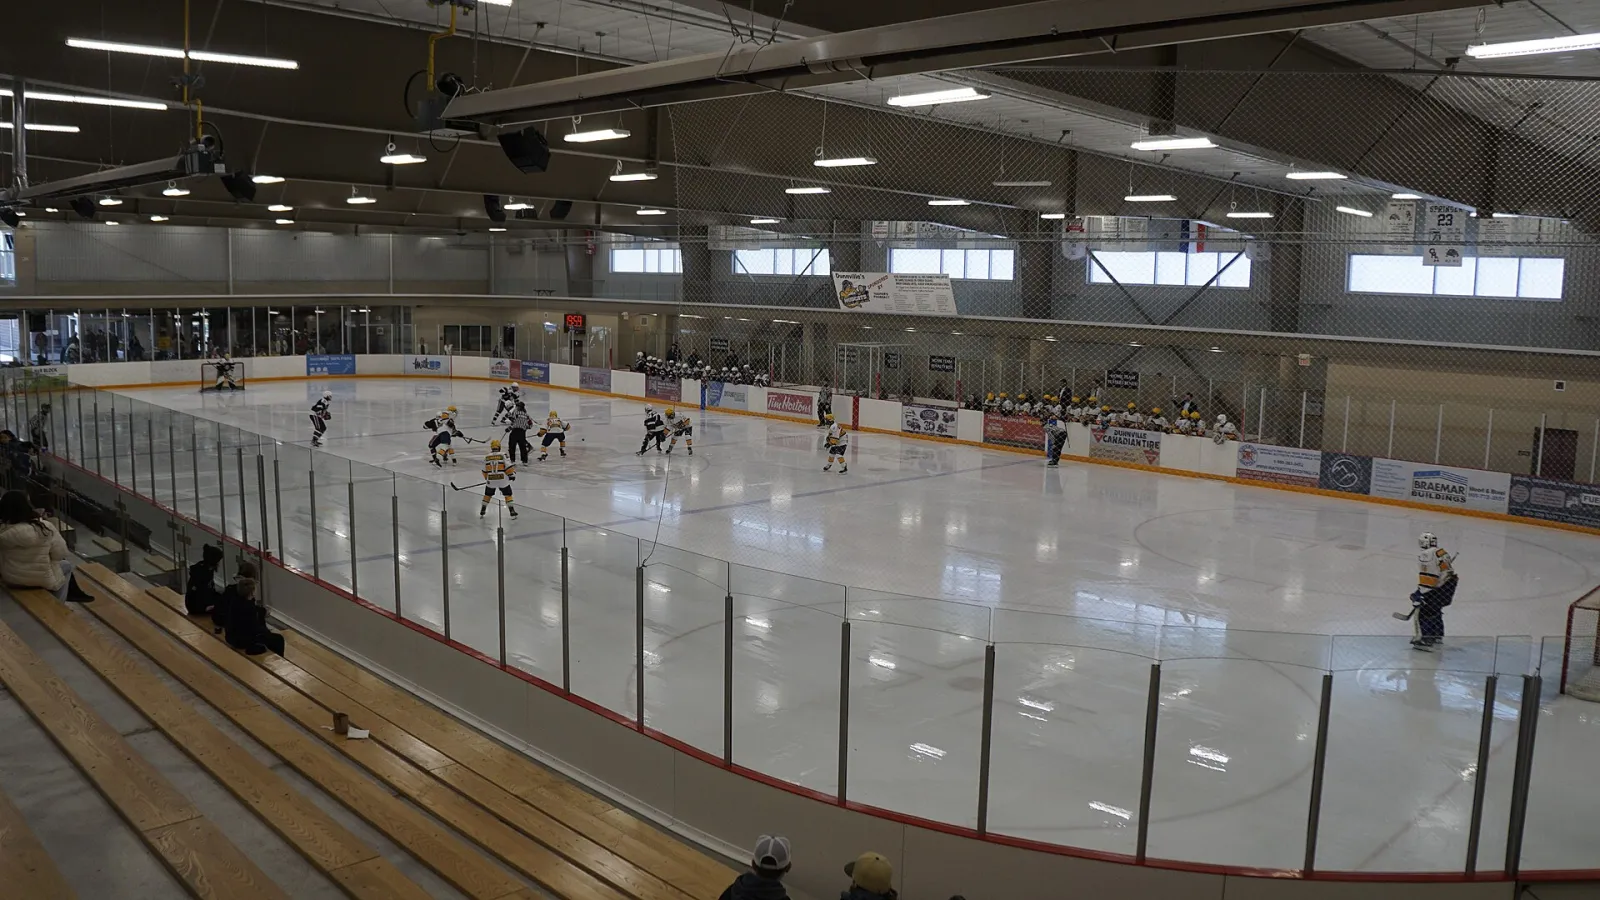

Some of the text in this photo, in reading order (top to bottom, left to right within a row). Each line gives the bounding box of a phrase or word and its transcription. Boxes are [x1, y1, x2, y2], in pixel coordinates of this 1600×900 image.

[1437, 213, 1453, 226] 23
[835, 272, 865, 280] Dunnville's
[768, 394, 812, 415] Tim Hortons
[1113, 429, 1148, 440] DUNNVILLE
[1102, 434, 1161, 450] CANADIAN TIRE
[1414, 480, 1465, 495] BRAEMAR
[1411, 490, 1467, 504] BUILDINGS
